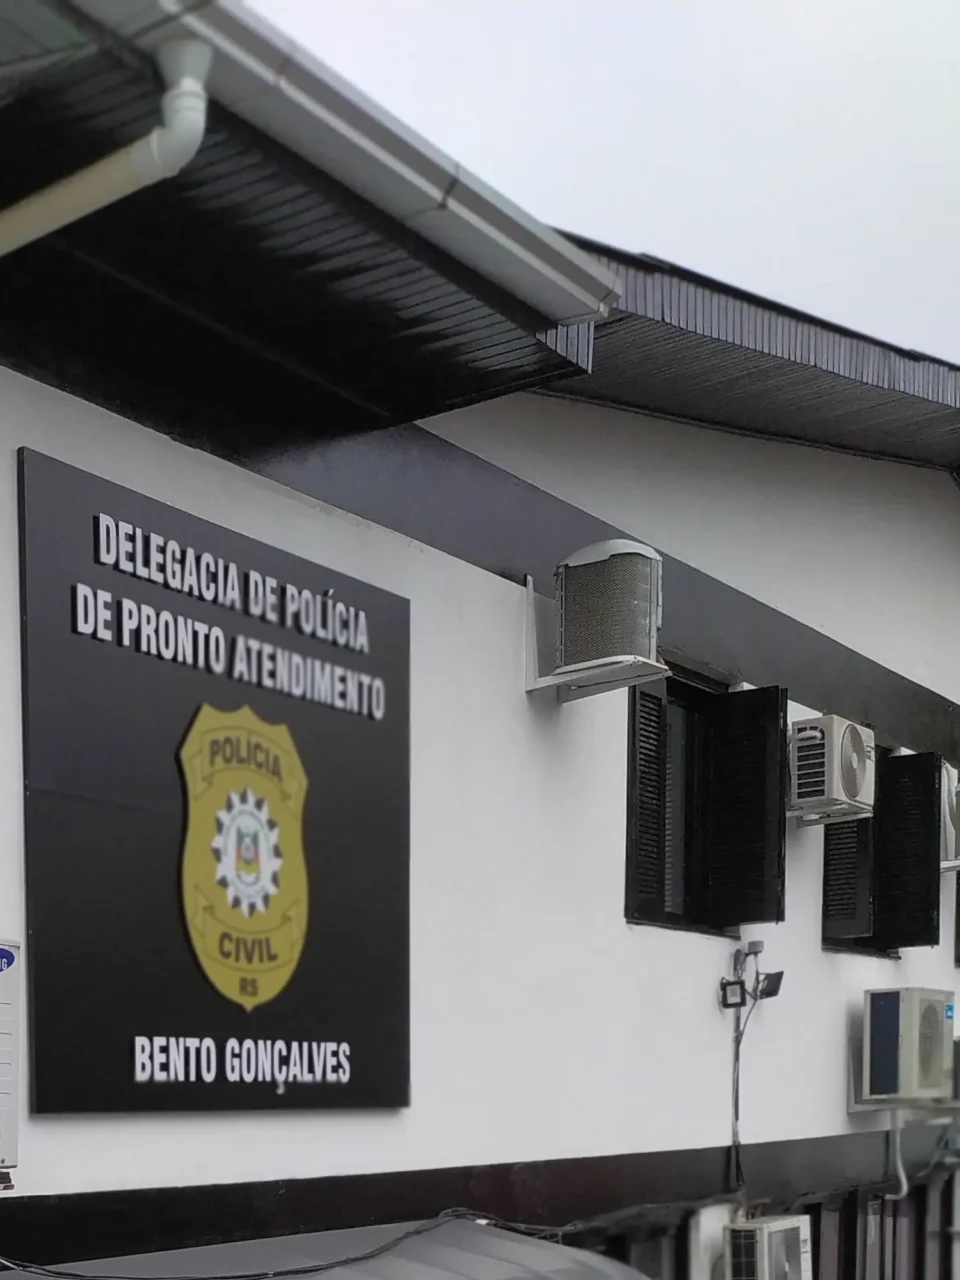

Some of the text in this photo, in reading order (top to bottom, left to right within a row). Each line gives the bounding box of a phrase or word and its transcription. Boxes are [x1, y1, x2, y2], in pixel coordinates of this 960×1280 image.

[98, 512, 370, 655] DELEGACIA DE POLÍCIA
[76, 582, 385, 721] DE PRONTO ATENDIMENTO
[218, 931, 279, 965] CIVIL
[239, 976, 259, 997] RS
[134, 1035, 351, 1095] BENTO GONÇALVES
